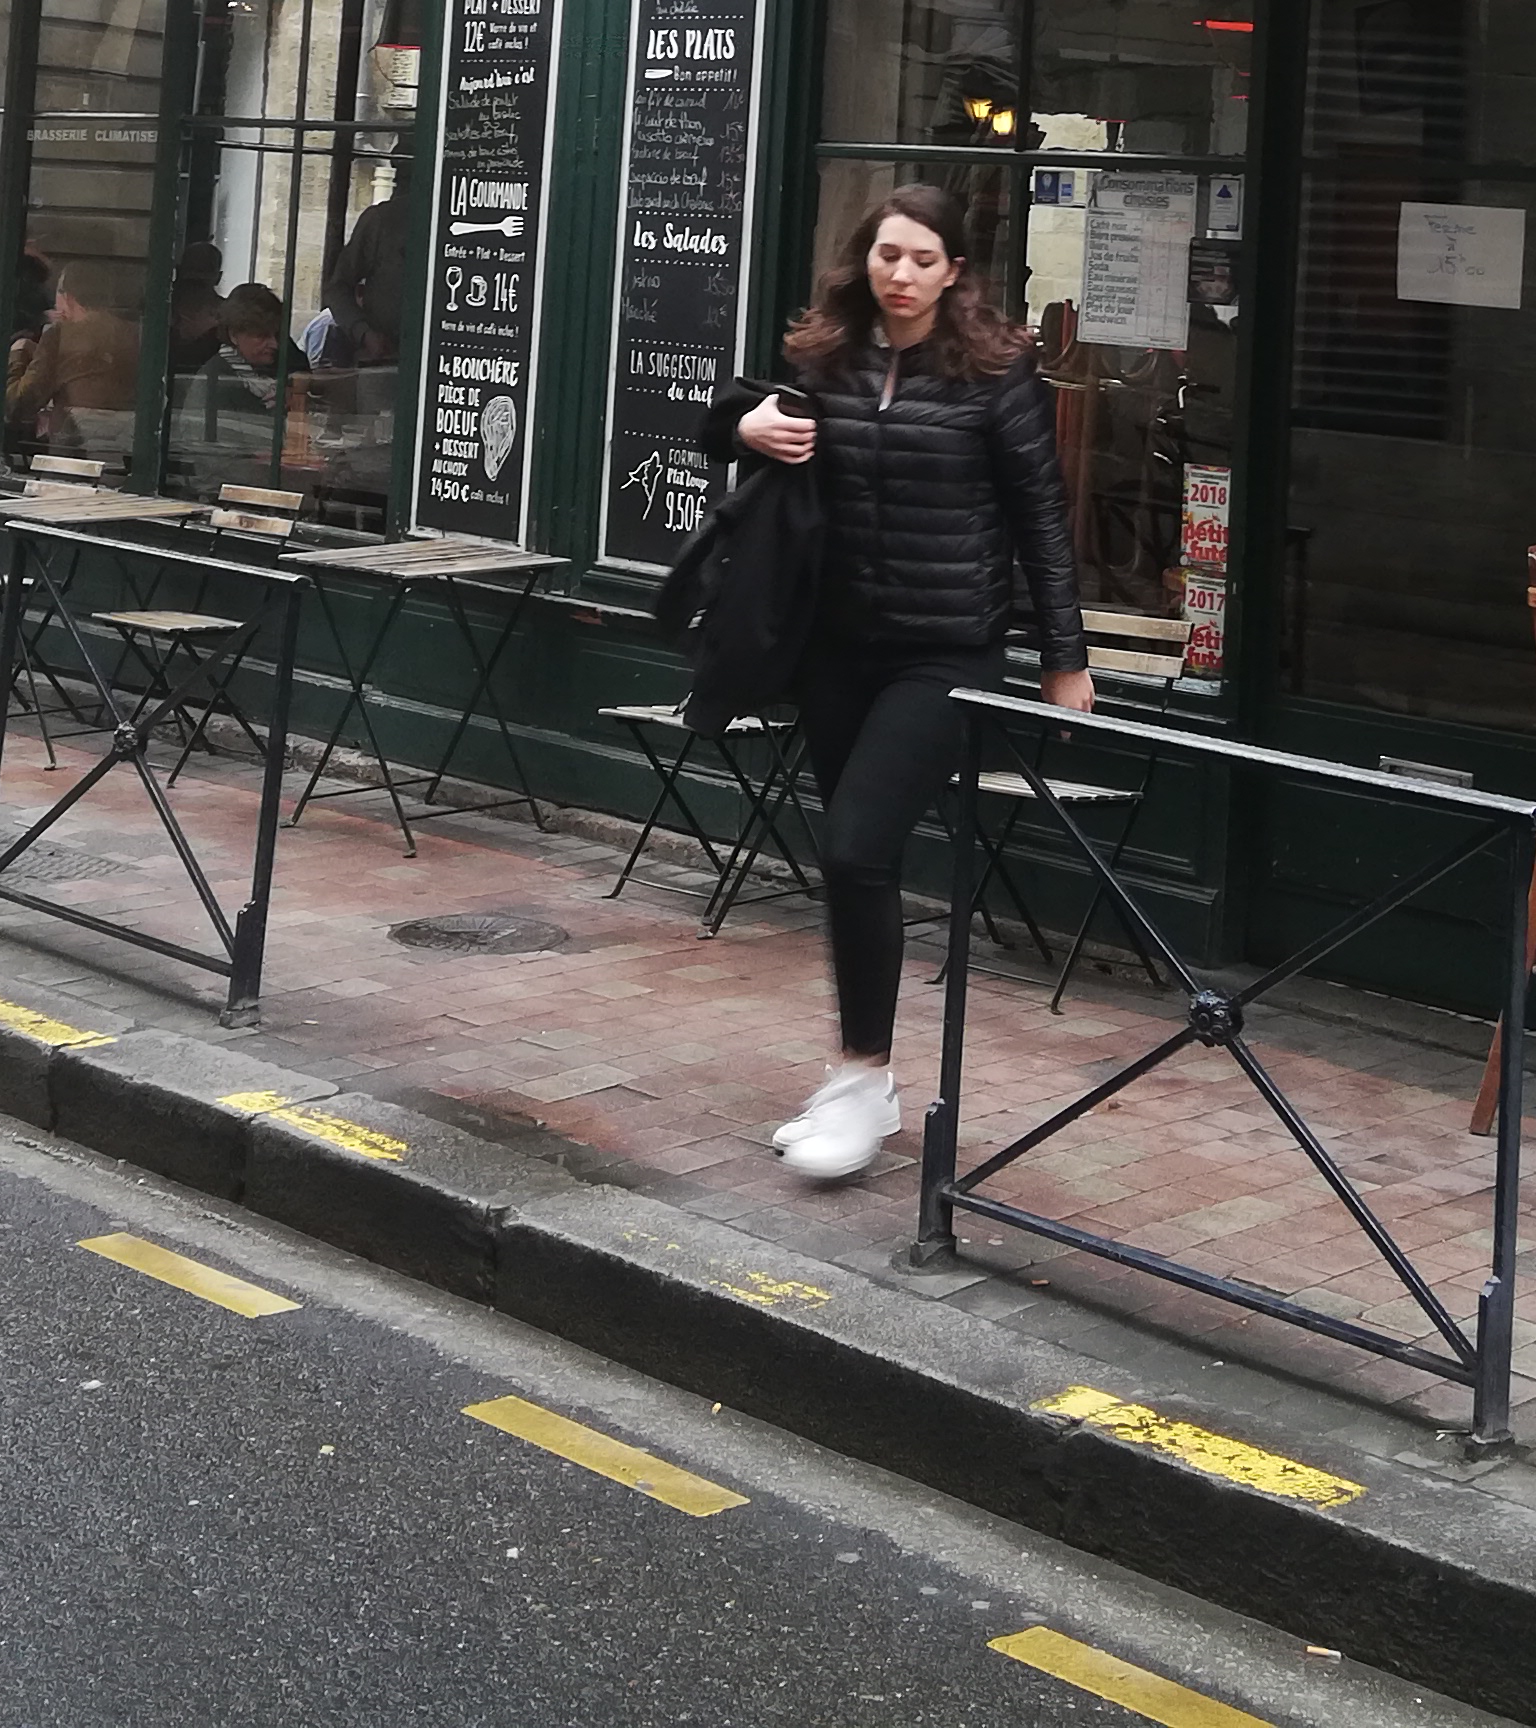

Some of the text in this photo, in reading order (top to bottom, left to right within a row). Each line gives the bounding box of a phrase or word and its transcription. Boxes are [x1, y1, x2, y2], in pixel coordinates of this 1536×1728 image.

[463, 21, 486, 52] 12€
[646, 28, 735, 60] LES PLATS
[674, 65, 692, 81] Bon
[27, 129, 88, 141] BRASSERIE
[450, 175, 529, 216] LA GOURMANDE
[1099, 175, 1195, 194] Consommations
[662, 222, 729, 255] Salades
[444, 243, 525, 262] Entrée Plat Dessert
[492, 272, 520, 313] 14€
[630, 349, 716, 381] LA SUGGESTION
[438, 381, 481, 407] PIÈCE DE
[667, 381, 714, 408] du chef
[436, 407, 479, 437] BOEUF
[442, 438, 479, 459] DESSERT
[668, 448, 709, 470] FORMULE
[432, 458, 468, 477] AU CHOIX
[430, 477, 460, 502] 14,50
[461, 484, 470, 502] €
[1191, 483, 1227, 506] 2018
[665, 491, 706, 532] 9,50€
[1188, 588, 1226, 612] 2017
